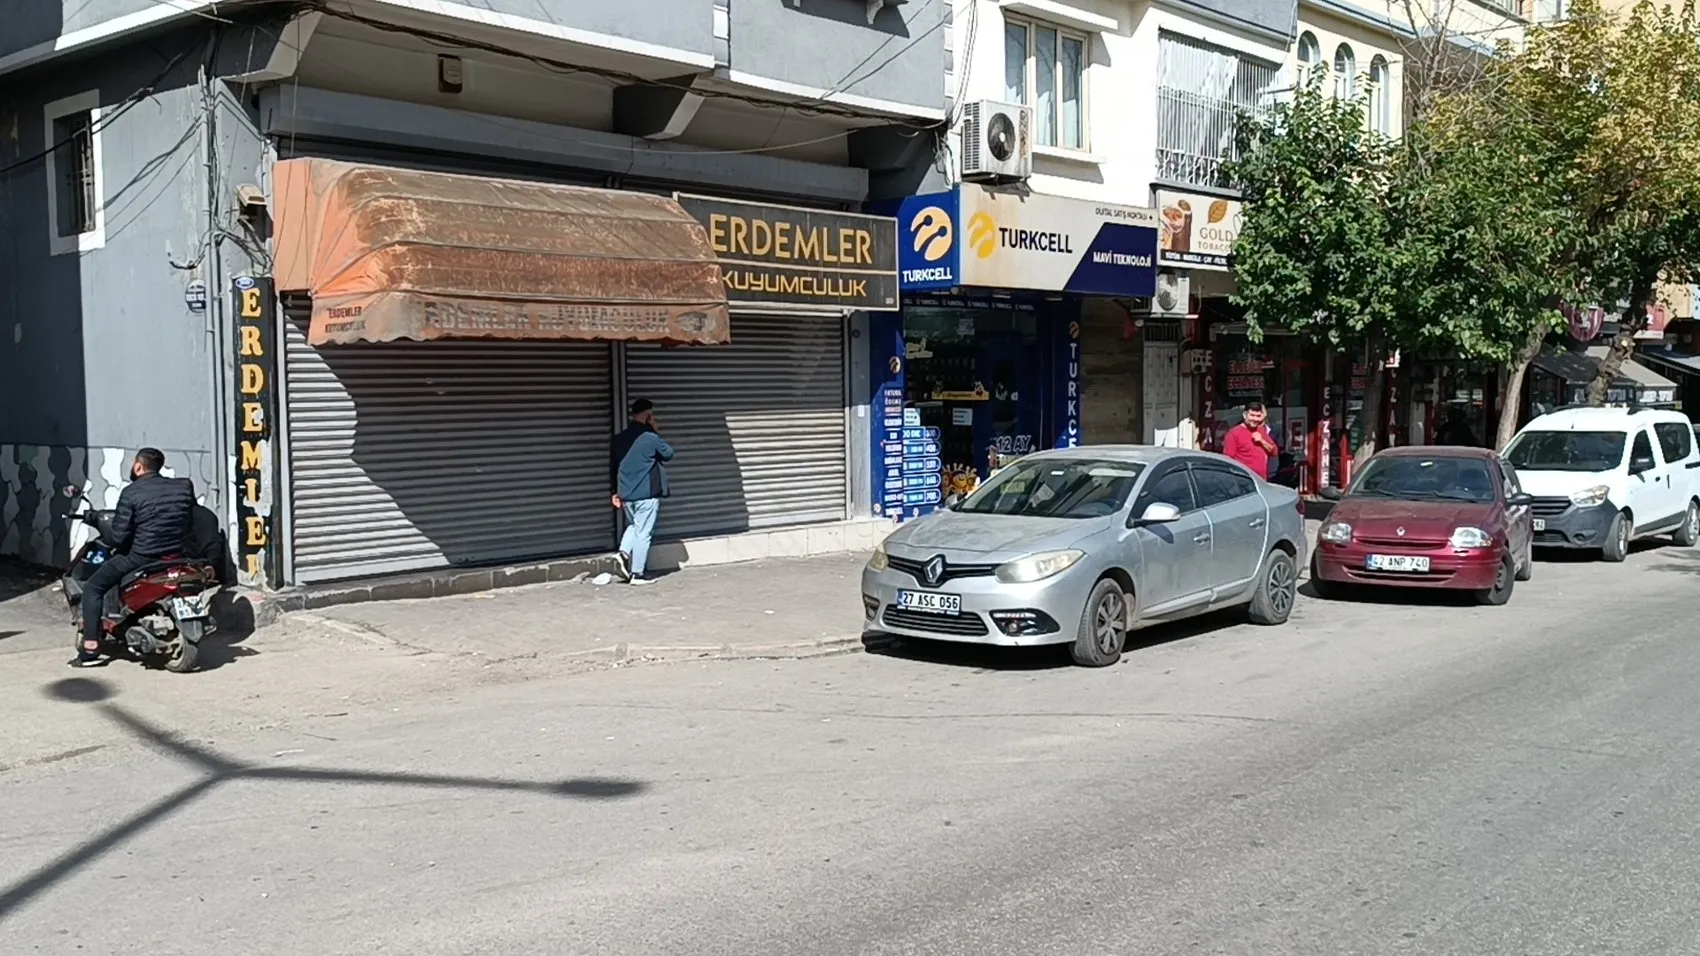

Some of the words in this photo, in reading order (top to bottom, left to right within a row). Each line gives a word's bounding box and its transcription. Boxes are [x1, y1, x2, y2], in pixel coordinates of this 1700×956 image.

[709, 213, 873, 265] ERDEMLER
[998, 227, 1073, 254] TURKCELL
[1199, 227, 1234, 242] GOLD
[902, 267, 953, 284] TURKCELL
[1388, 556, 1406, 567] ANP
[1410, 557, 1428, 568] 740
[903, 592, 914, 605] 27
[917, 594, 935, 607] ASC
[939, 596, 959, 609] 056
